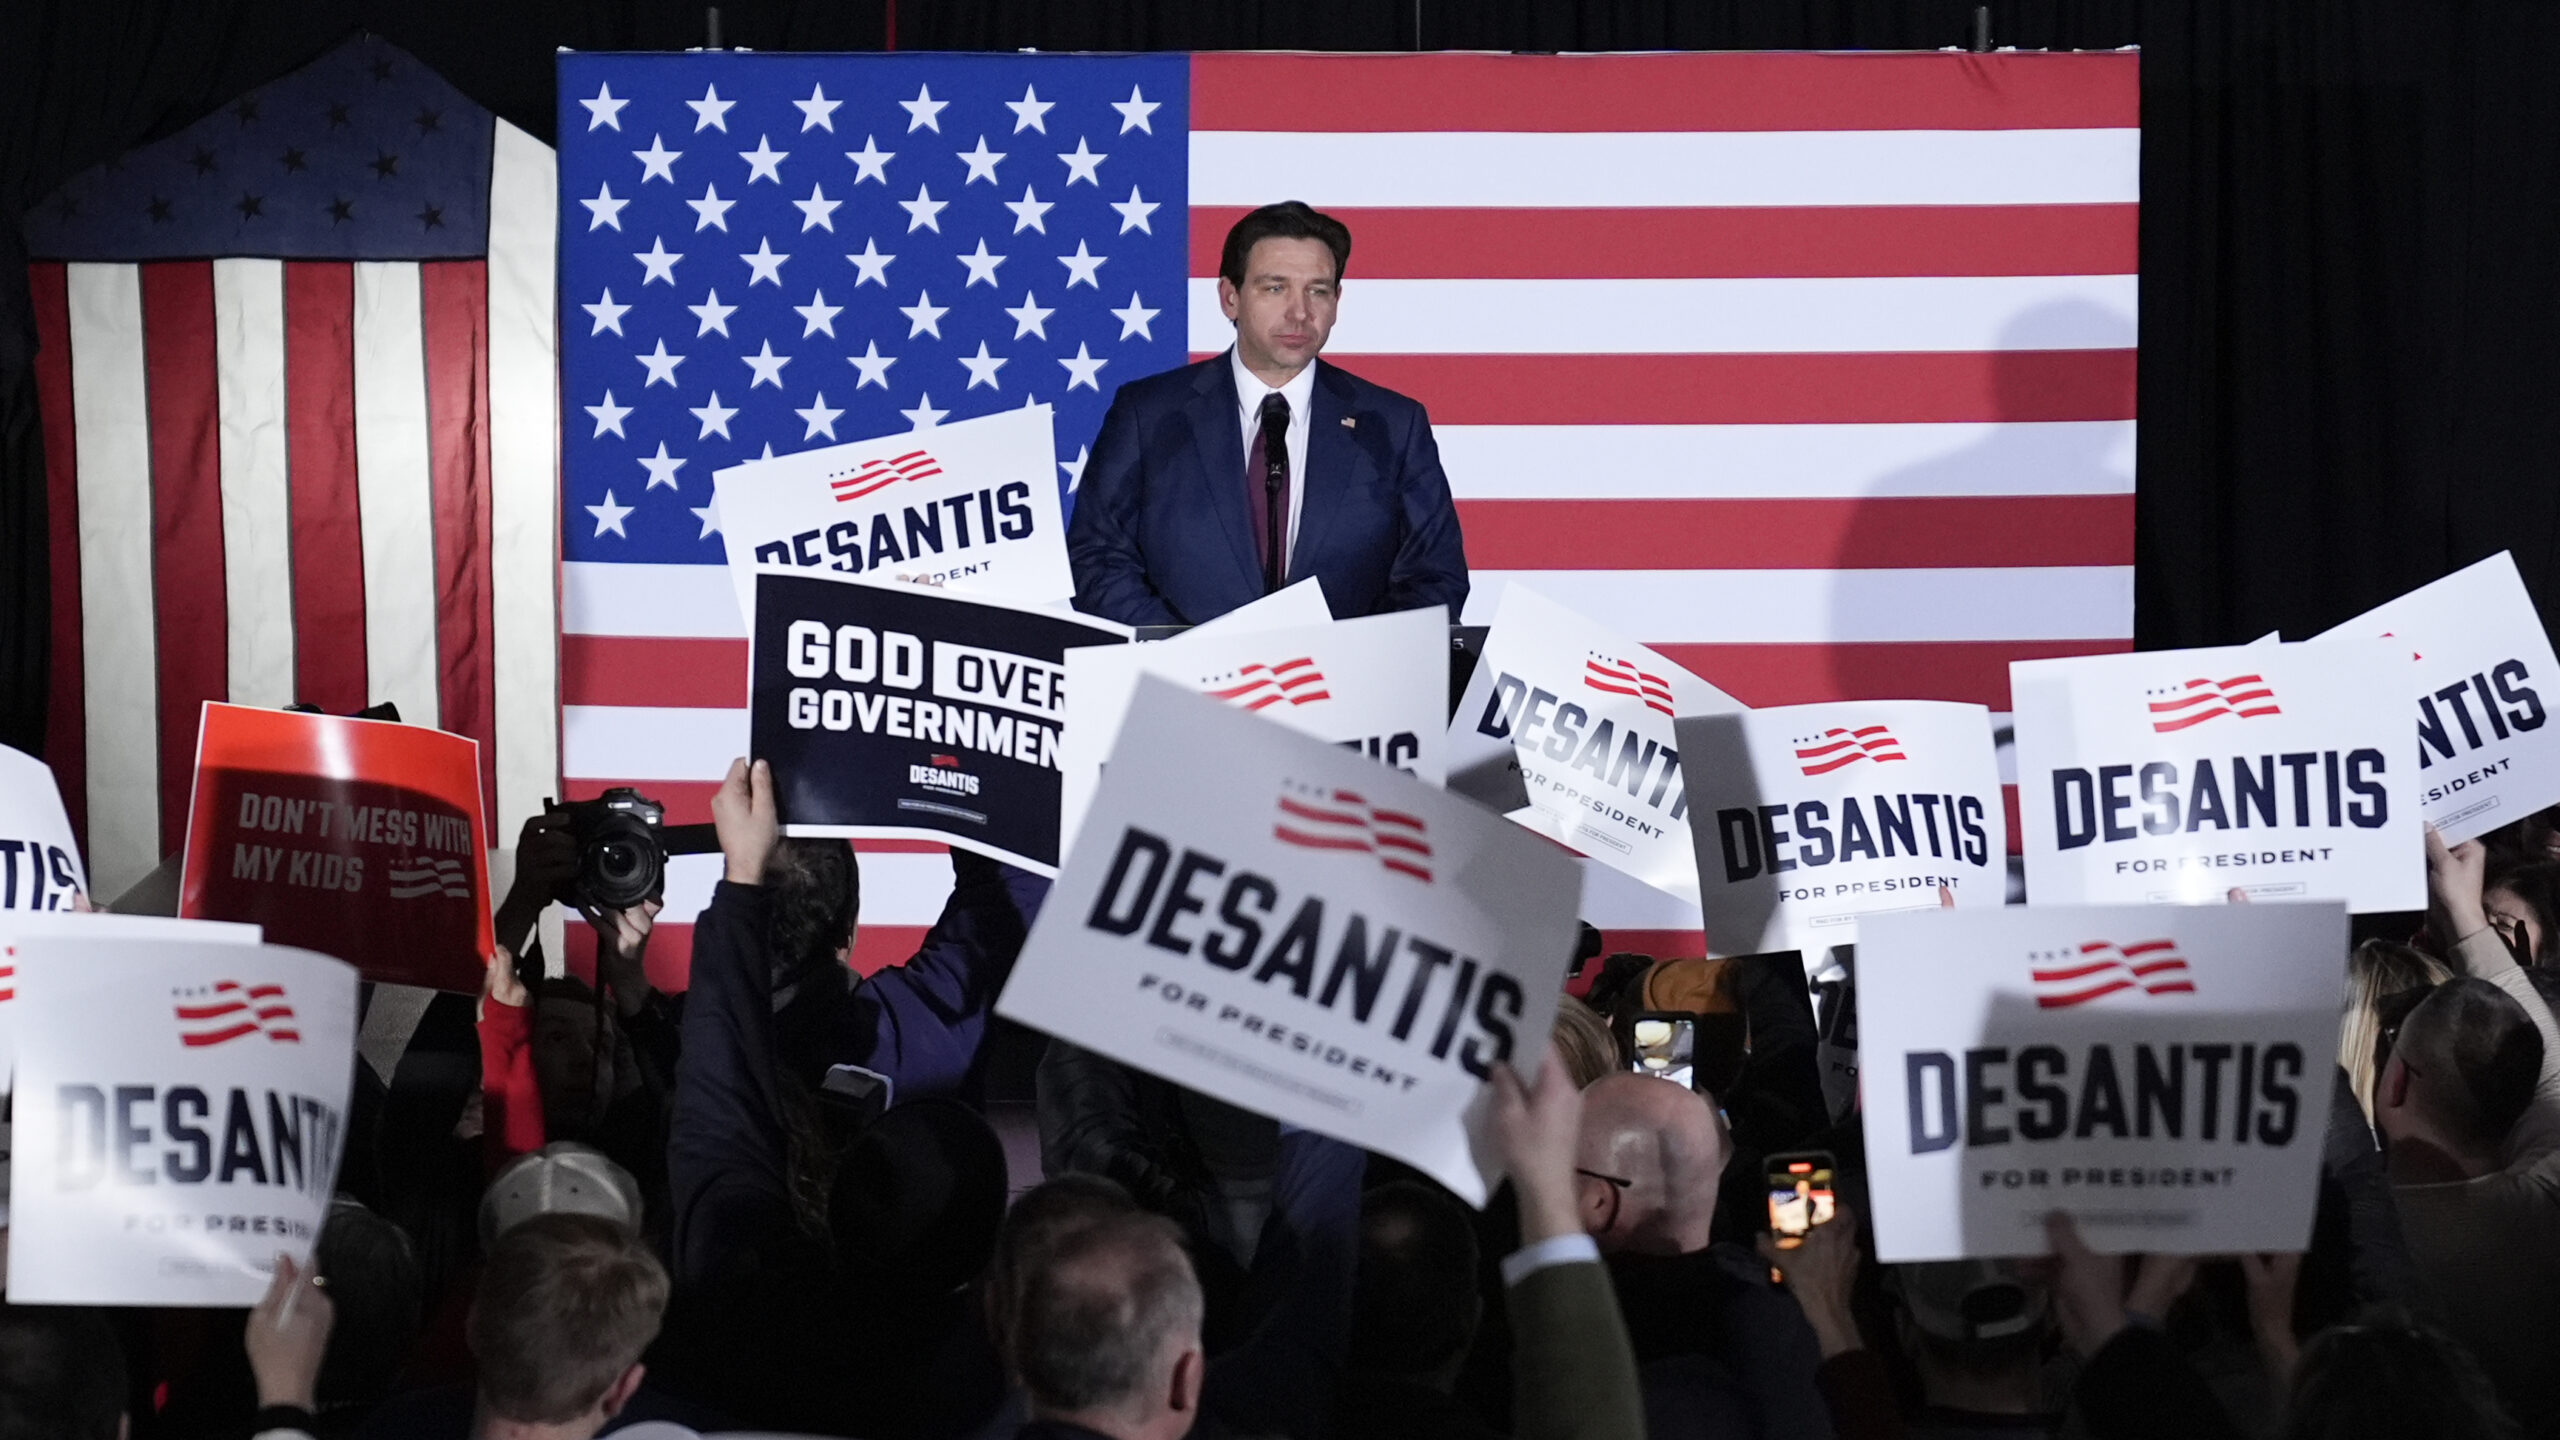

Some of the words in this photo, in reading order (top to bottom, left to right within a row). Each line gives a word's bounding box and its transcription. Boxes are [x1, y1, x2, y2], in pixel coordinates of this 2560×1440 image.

[787, 619, 924, 690] GOD
[957, 654, 1065, 713] OVER
[788, 687, 1063, 773] GOVERNMEN
[909, 764, 980, 795] DESANTIS
[1507, 760, 1548, 786] FOR
[2051, 747, 2389, 852] DESANTIS
[2421, 758, 2511, 806] SIDENT
[238, 792, 335, 838] DON'T
[345, 804, 418, 848] MESS
[424, 811, 472, 857] WITH
[1717, 793, 1988, 884] DESANTIS
[232, 843, 284, 882] MY
[288, 849, 365, 893] KIDS
[1779, 886, 1826, 902] FOR
[1835, 875, 1960, 897] PRESIDENT
[2115, 858, 2168, 874] FOR
[1085, 823, 1526, 1083] DESANTIS
[1139, 972, 1208, 1012] FOR
[1218, 1003, 1420, 1092] PRESIDENT
[1904, 1041, 2306, 1156] DESANTIS
[1979, 1166, 2052, 1190] FOR
[2061, 1165, 2238, 1189] PRESIDENT
